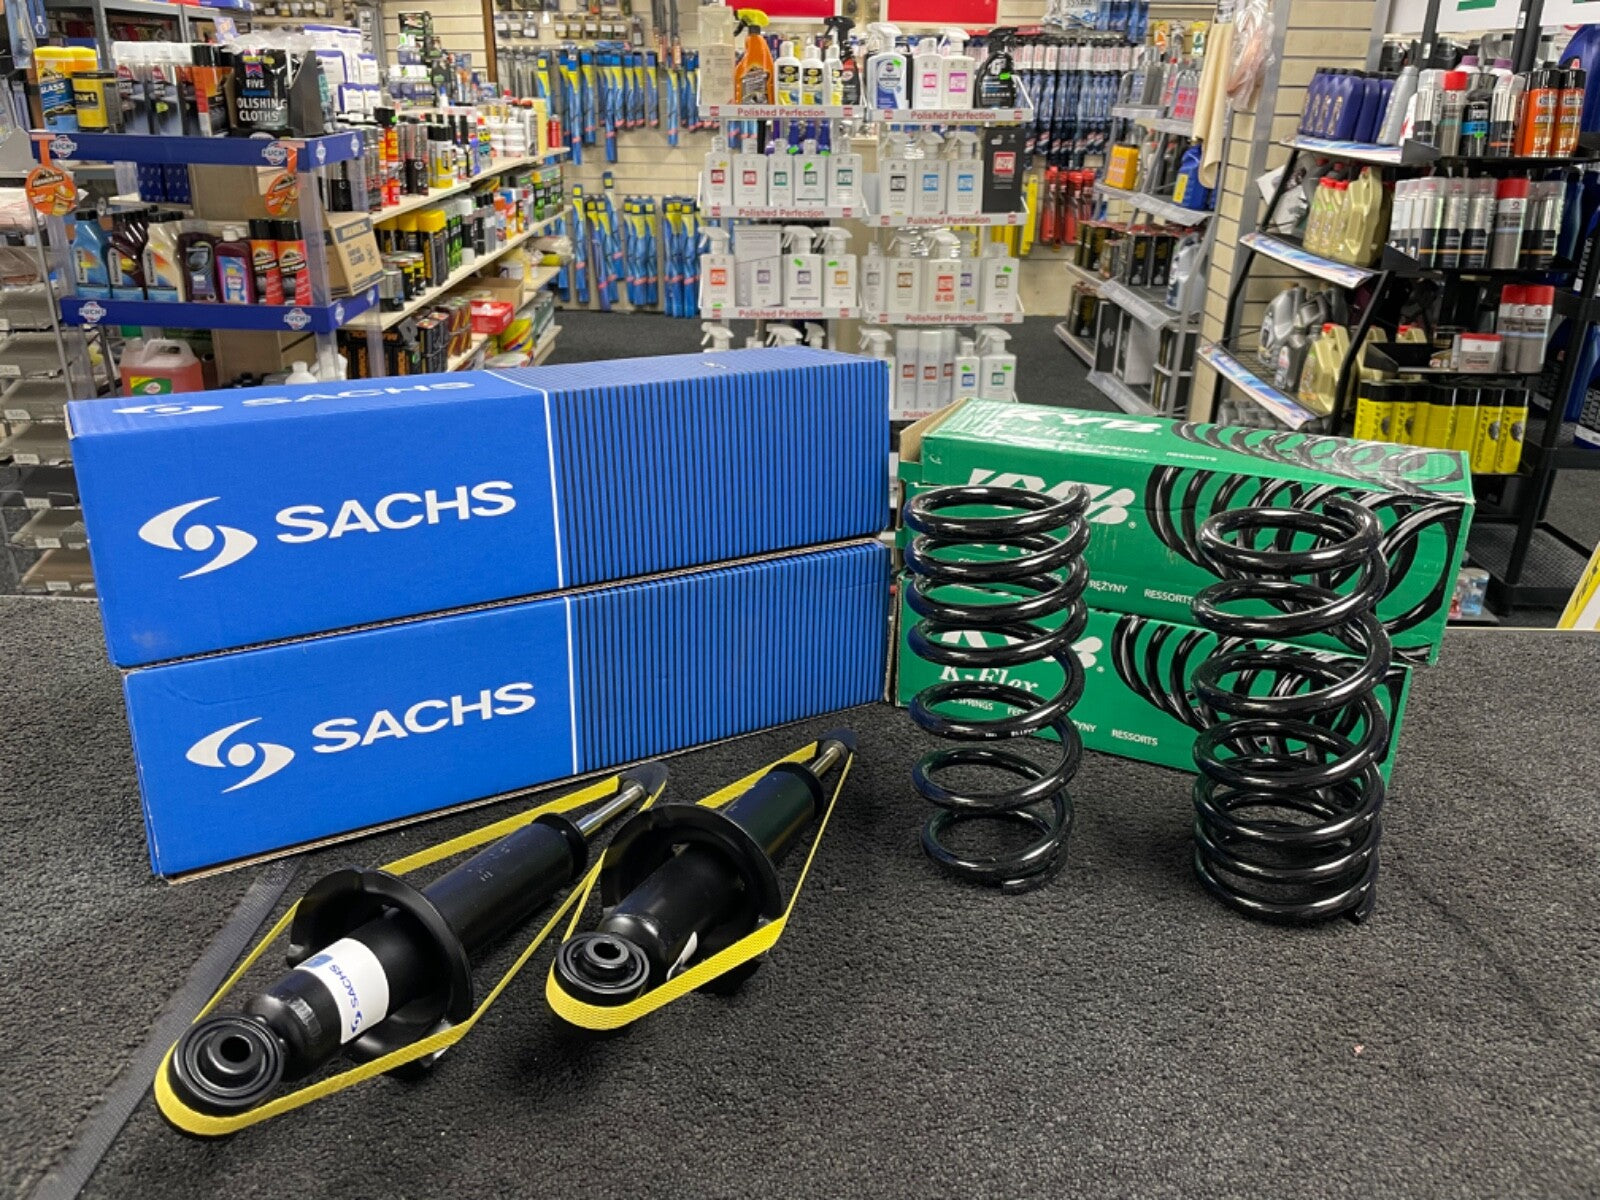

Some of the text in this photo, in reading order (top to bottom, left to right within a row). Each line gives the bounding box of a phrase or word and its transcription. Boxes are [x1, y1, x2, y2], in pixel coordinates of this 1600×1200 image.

[246, 79, 265, 88] FIVE
[237, 97, 287, 109] OLISHING
[239, 111, 279, 122] CLOTHS
[737, 107, 826, 117] Polished Perfection
[911, 110, 996, 120] Polished Perfection
[739, 208, 825, 218] Polished Perfection
[907, 216, 945, 225] Polished
[738, 309, 823, 318] Polished Perfection
[906, 313, 988, 322] Polished Perfection
[242, 381, 476, 407] SACHS
[997, 409, 1162, 433] KYB
[275, 480, 517, 544] SACHS
[940, 665, 1039, 693] K-Flex
[312, 681, 537, 755] SACHS
[1112, 728, 1158, 746] RESSORTS
[329, 964, 360, 1009] SACHS
